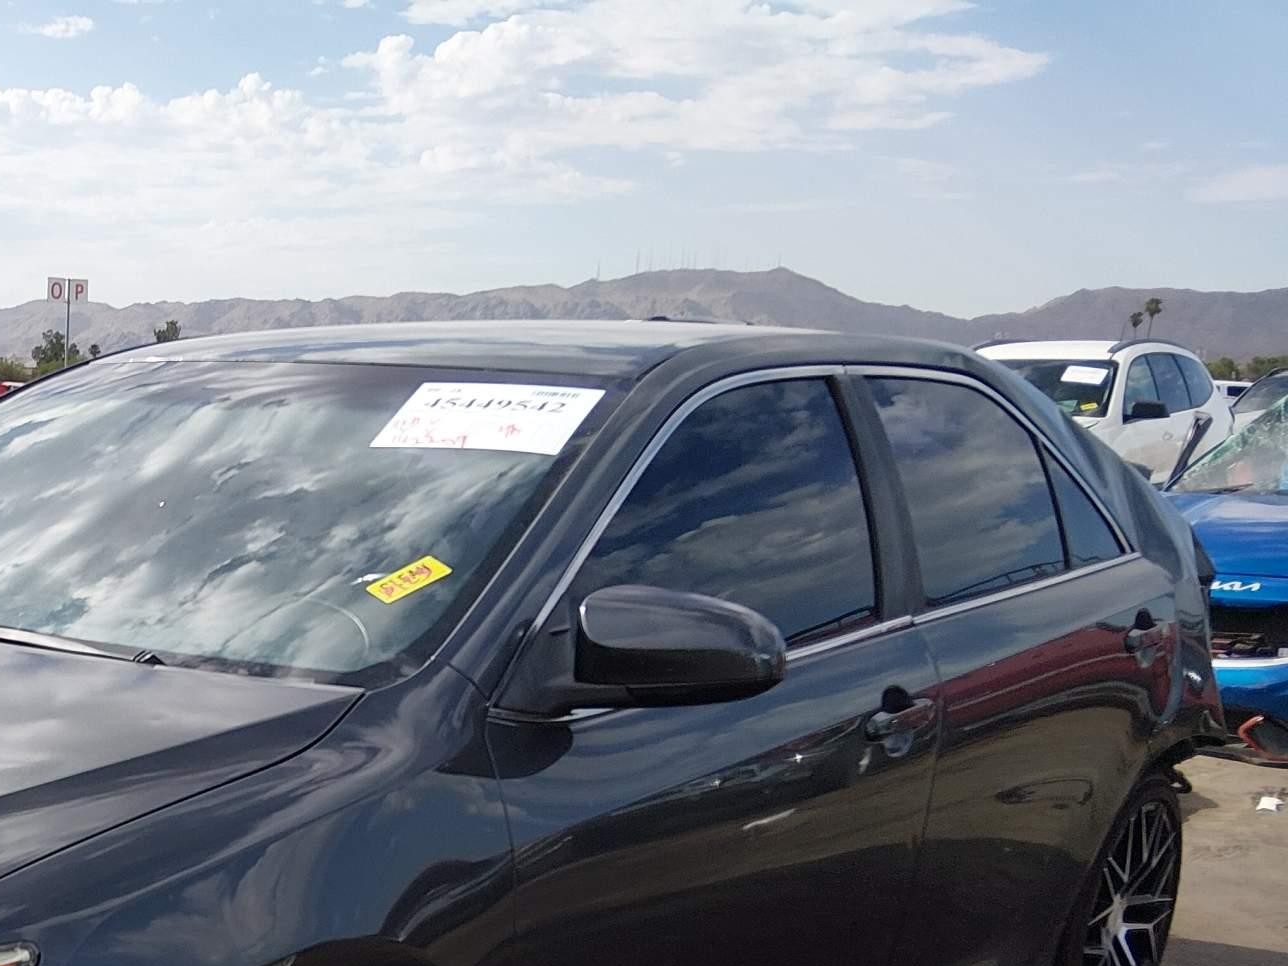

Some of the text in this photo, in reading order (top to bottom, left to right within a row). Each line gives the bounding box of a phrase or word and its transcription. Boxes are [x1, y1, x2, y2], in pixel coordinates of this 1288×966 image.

[51, 282, 84, 301] O P
[424, 397, 566, 413] 45449542
